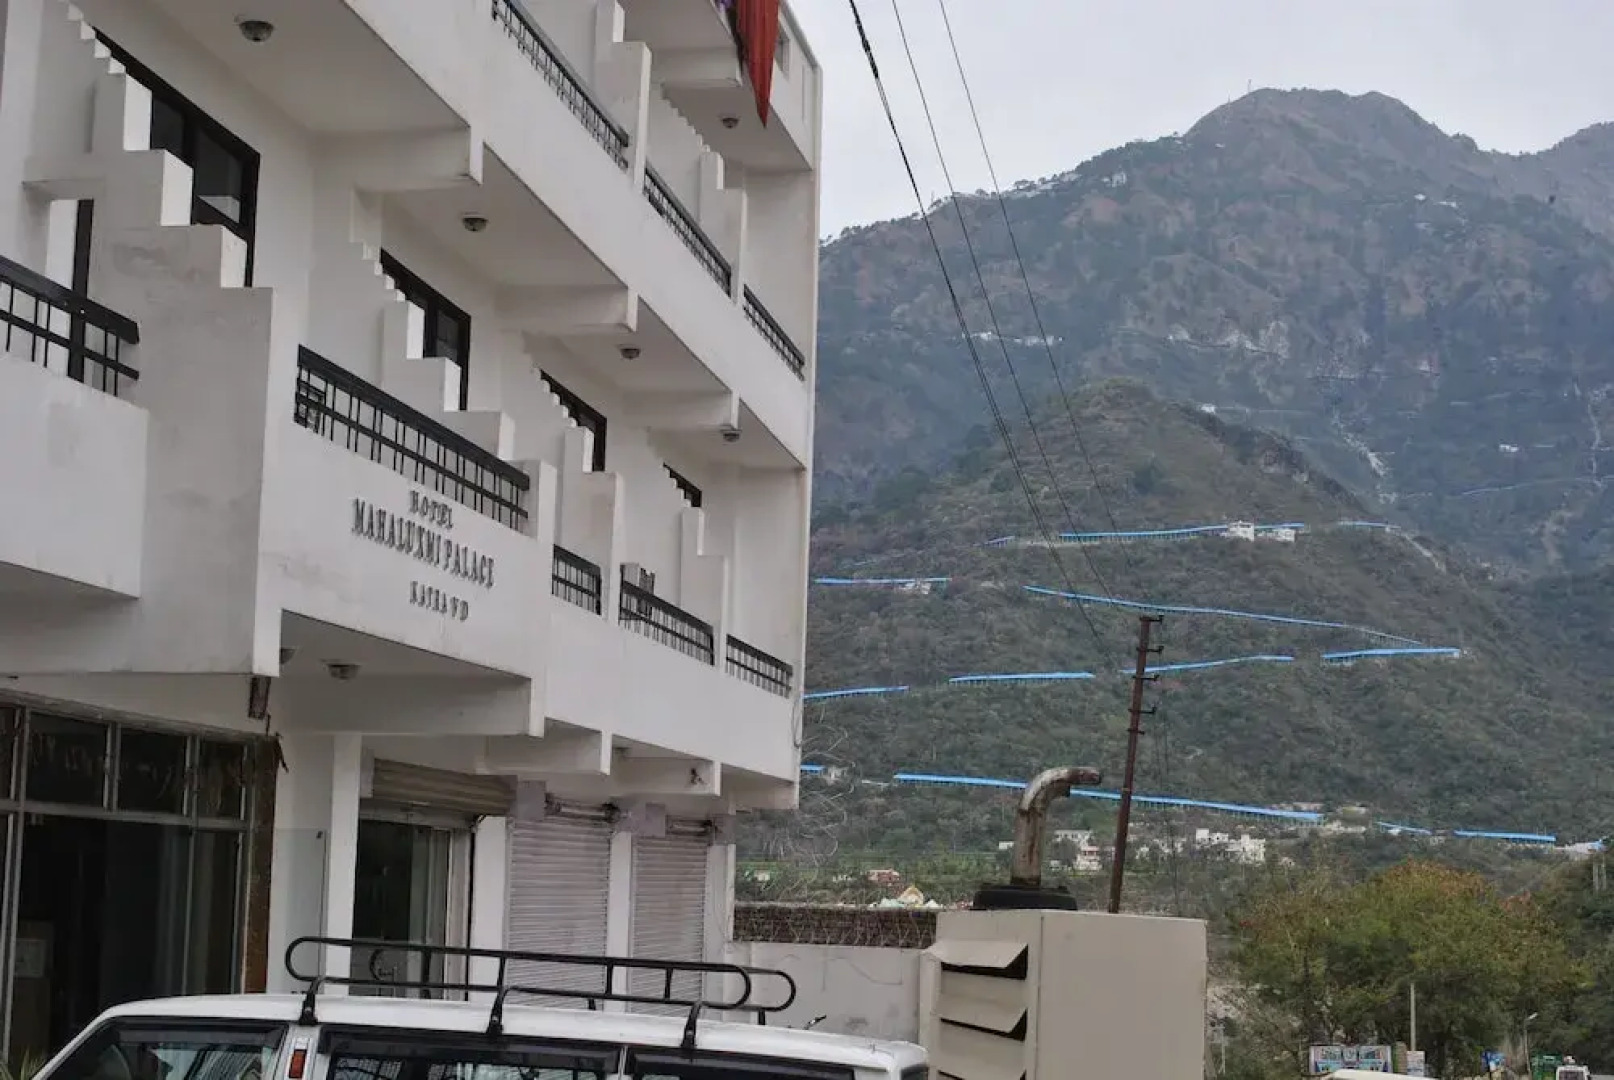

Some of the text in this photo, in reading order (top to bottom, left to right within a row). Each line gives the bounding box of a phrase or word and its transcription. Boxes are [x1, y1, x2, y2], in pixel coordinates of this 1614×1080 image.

[410, 490, 453, 530] HOTEL
[351, 498, 495, 589] MAHALUXMI PALACE
